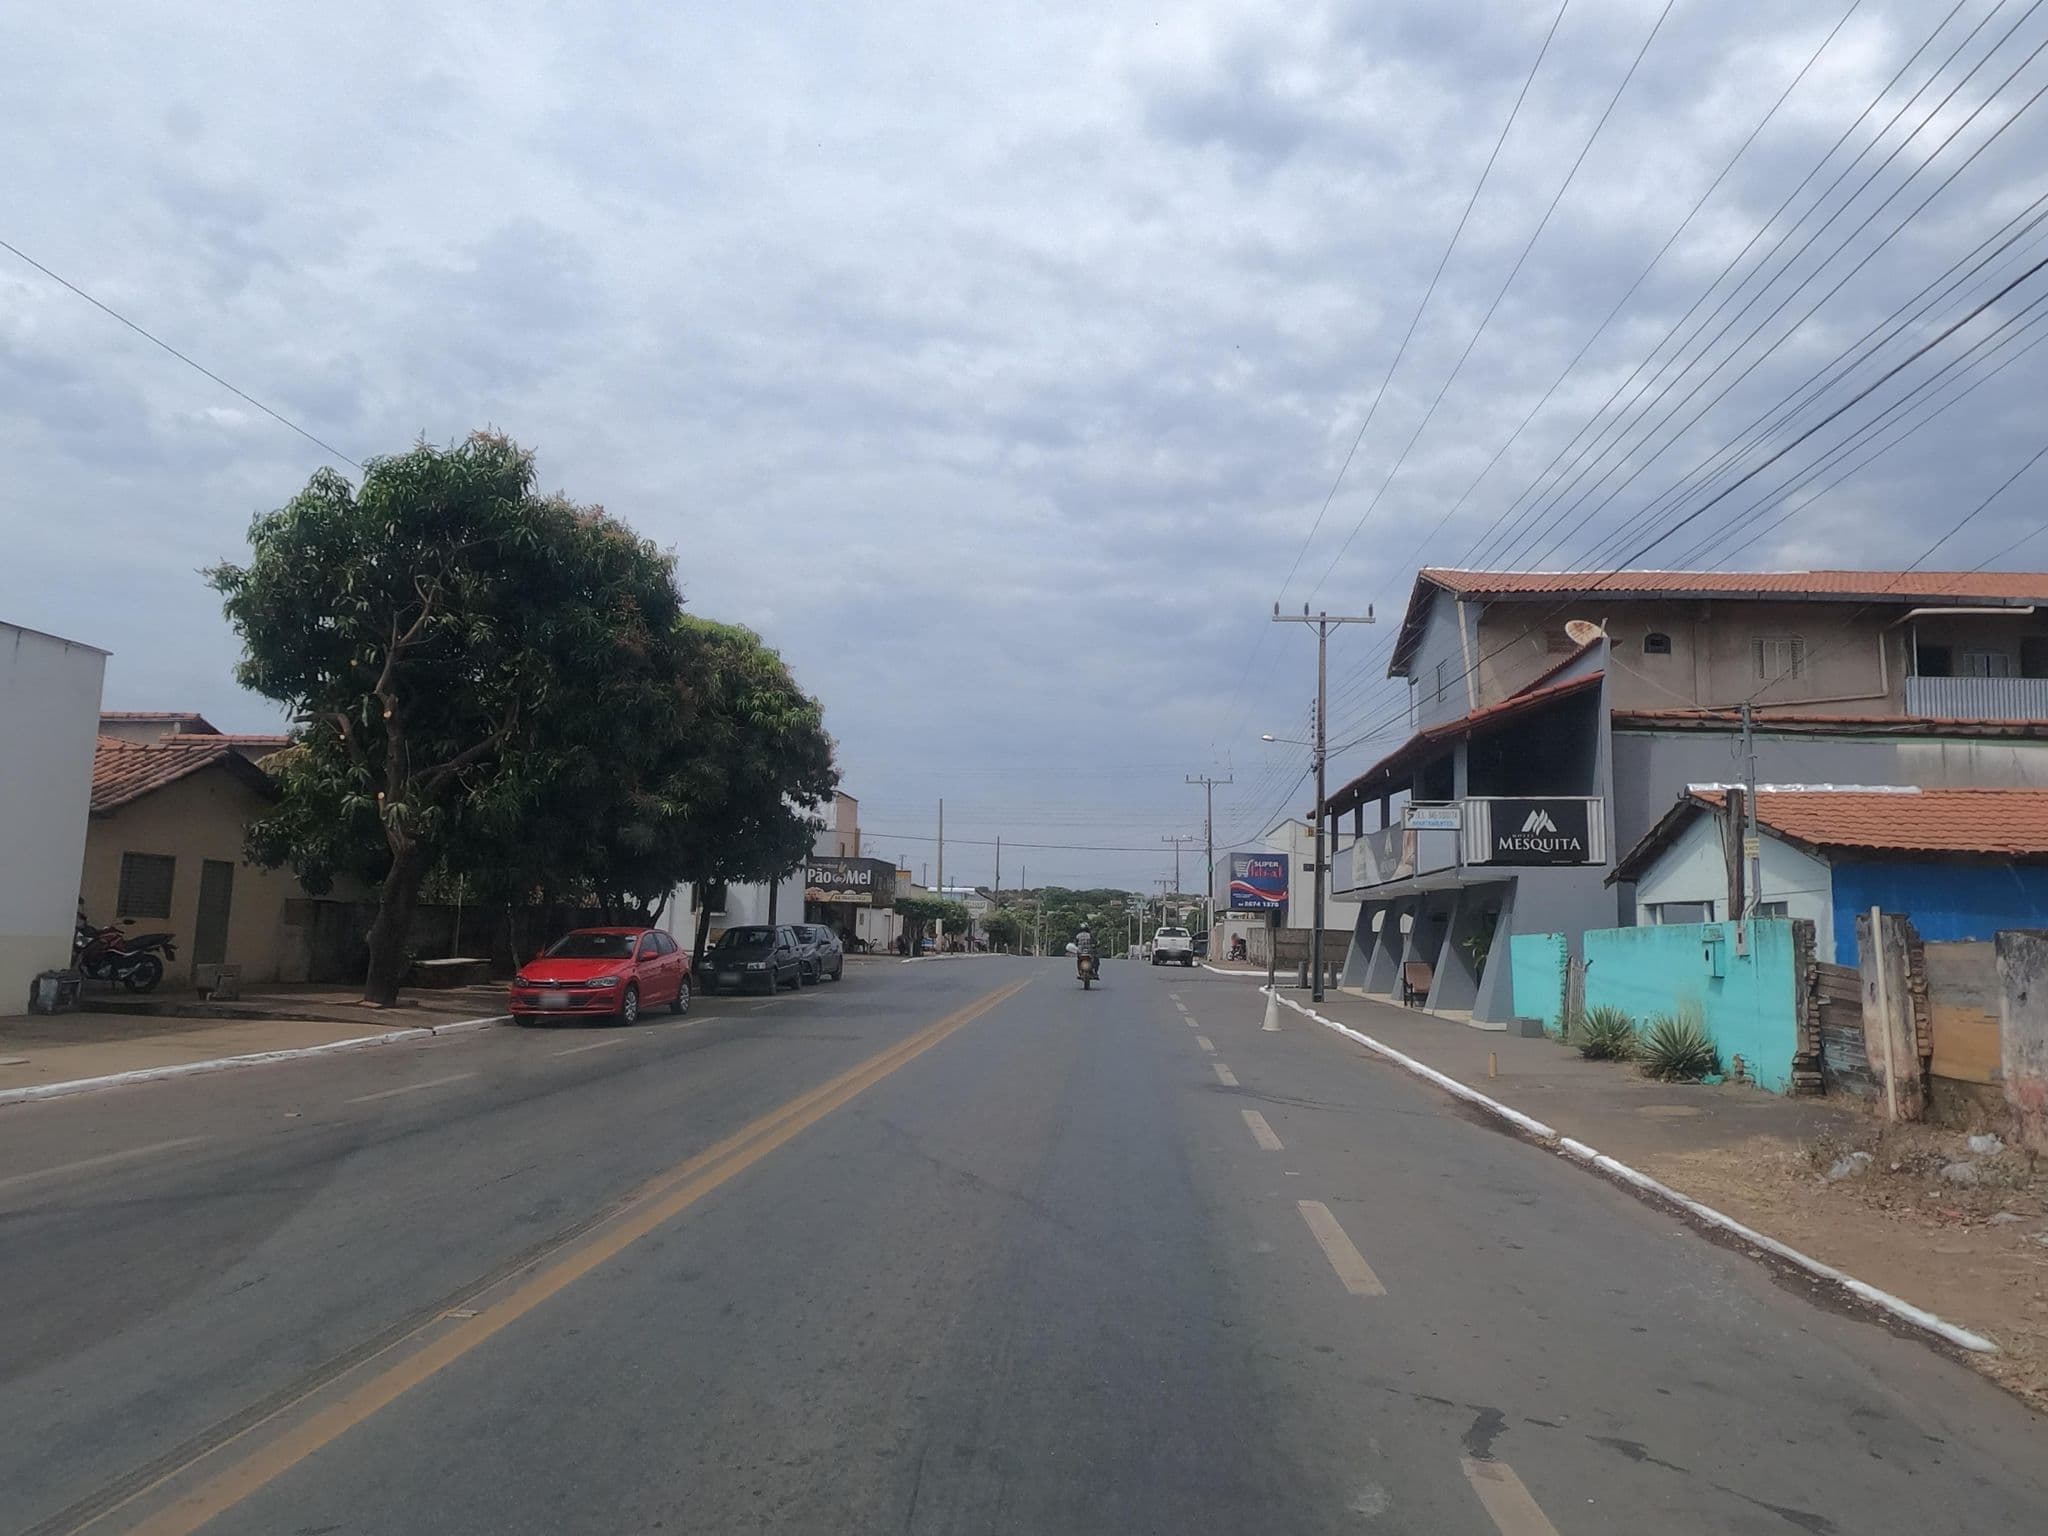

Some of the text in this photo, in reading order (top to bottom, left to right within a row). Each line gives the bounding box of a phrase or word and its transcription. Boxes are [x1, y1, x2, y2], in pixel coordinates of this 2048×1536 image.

[1498, 836, 1582, 853] MESQUITA
[807, 867, 832, 884] Pão
[846, 869, 872, 885] Mel
